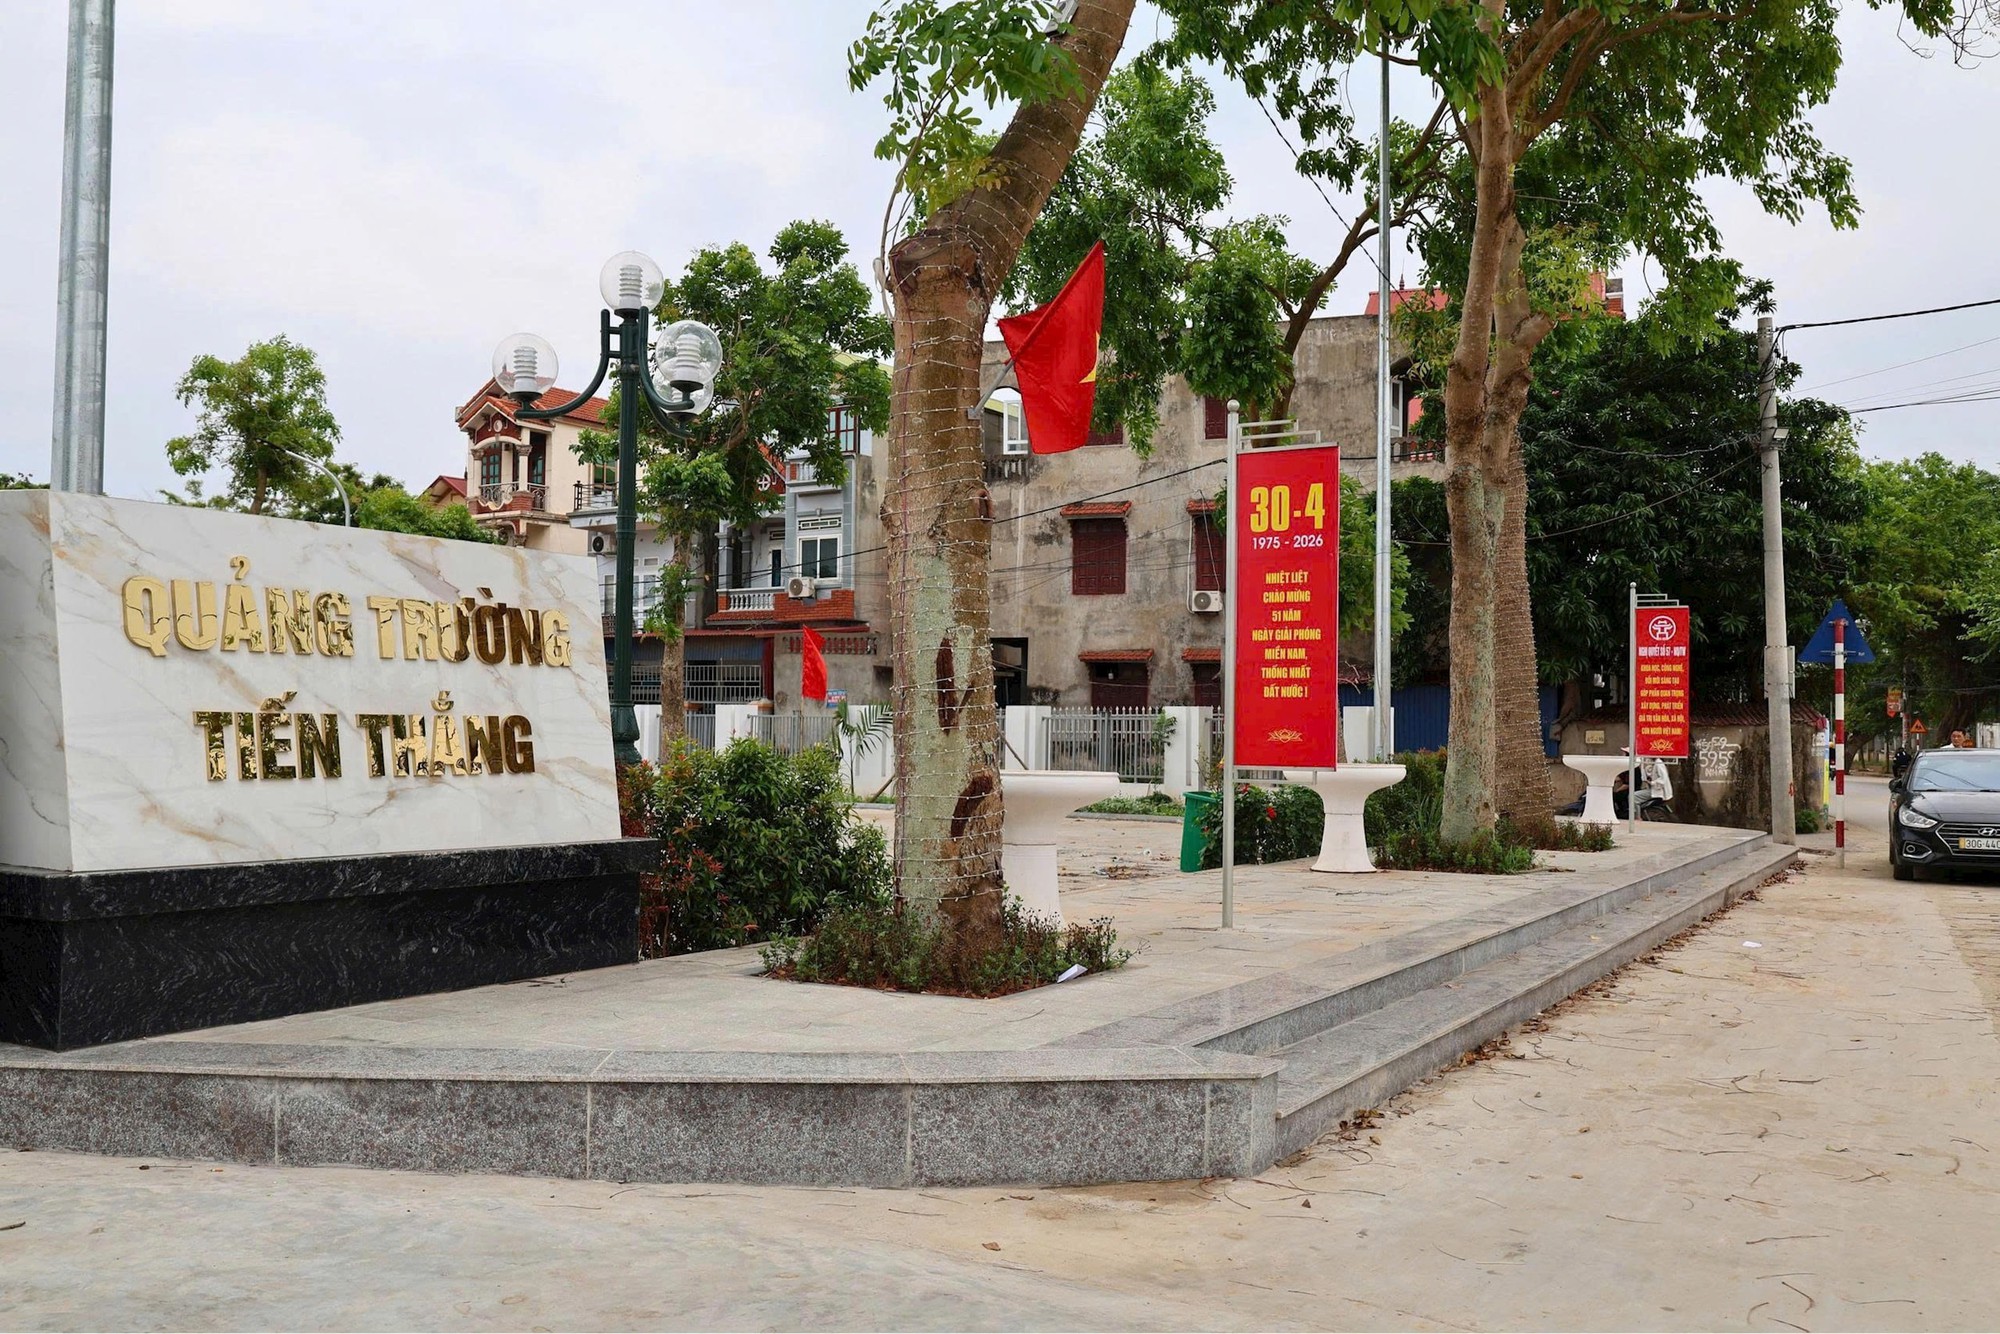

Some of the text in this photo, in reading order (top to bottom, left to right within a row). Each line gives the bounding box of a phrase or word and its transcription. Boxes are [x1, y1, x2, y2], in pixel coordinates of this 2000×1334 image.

[1250, 483, 1325, 532] 30-4
[1252, 536, 1281, 550] 1975
[1293, 533, 1324, 548] 2026
[1265, 569, 1309, 586] NHIỆT LIỆT
[1263, 587, 1311, 604] CHÀO MỪNG
[122, 555, 572, 668] QUẢNG TRƯỜNG
[1272, 608, 1302, 622] 51 NĂM
[1252, 625, 1322, 642] NGÀY GIẢI PHÓNG
[1261, 664, 1311, 679] THỐNG NHẤT
[1263, 683, 1280, 698] ĐẤT
[1280, 683, 1304, 698] NƯỚC
[193, 690, 535, 781] TIẾN THẮNG
